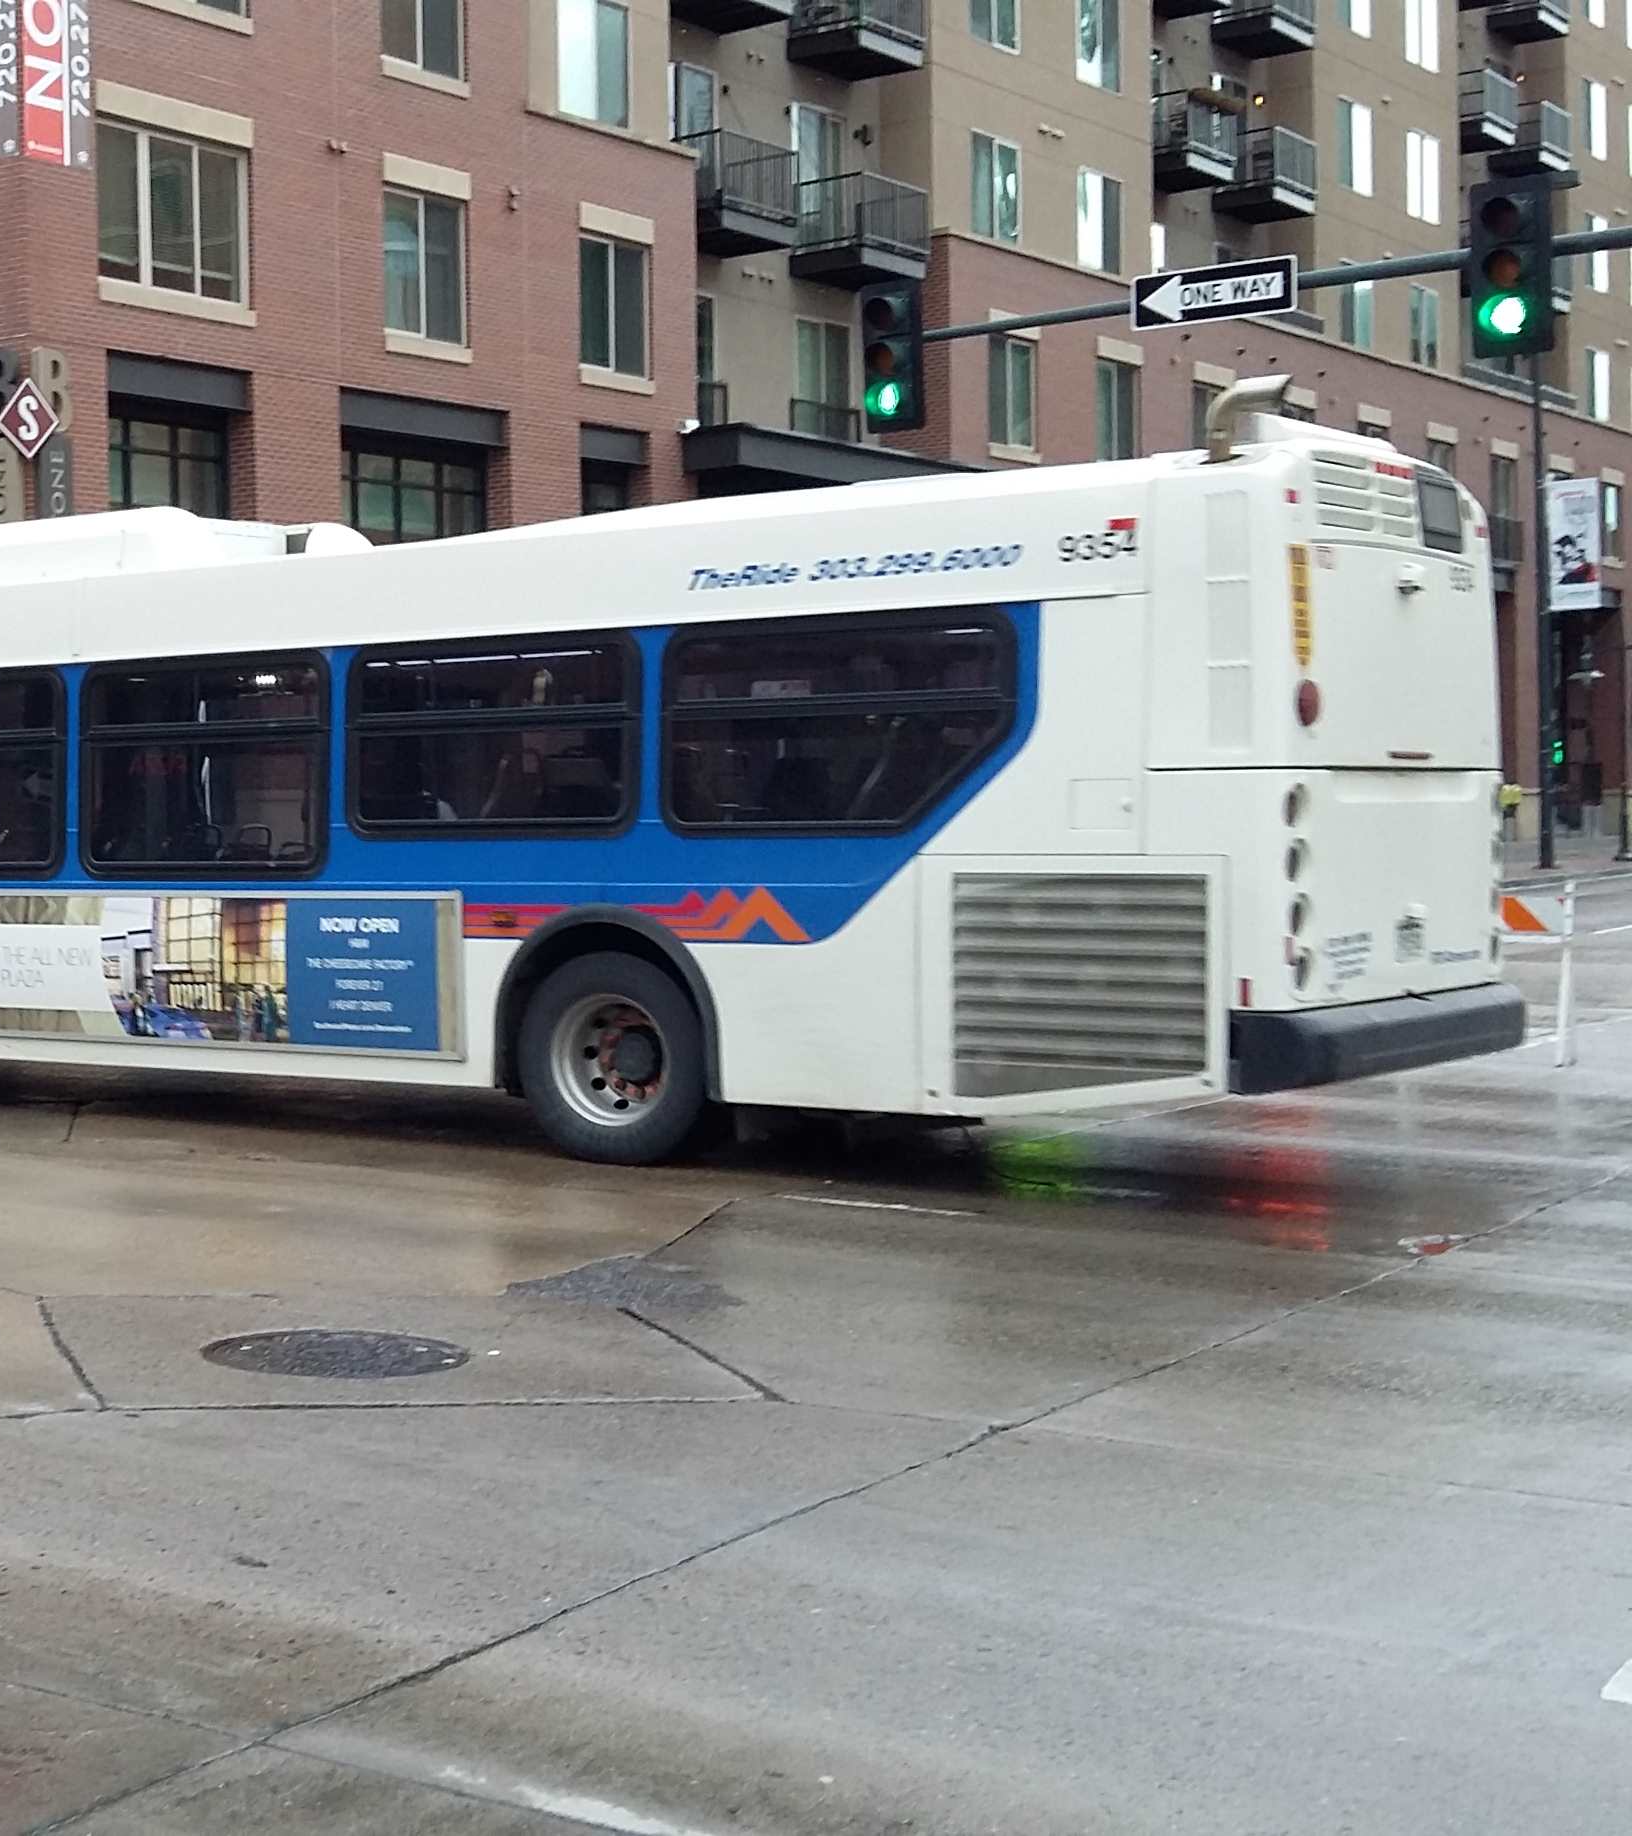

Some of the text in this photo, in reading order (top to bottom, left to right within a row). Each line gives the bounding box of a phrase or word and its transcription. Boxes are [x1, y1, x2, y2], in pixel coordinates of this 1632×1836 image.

[1179, 276, 1277, 307] ONE WAY
[18, 395, 39, 440] S
[1057, 532, 1138, 562] 9354
[688, 543, 1023, 591] TheRide 303.299.6000
[319, 917, 399, 934] NOW OPEN
